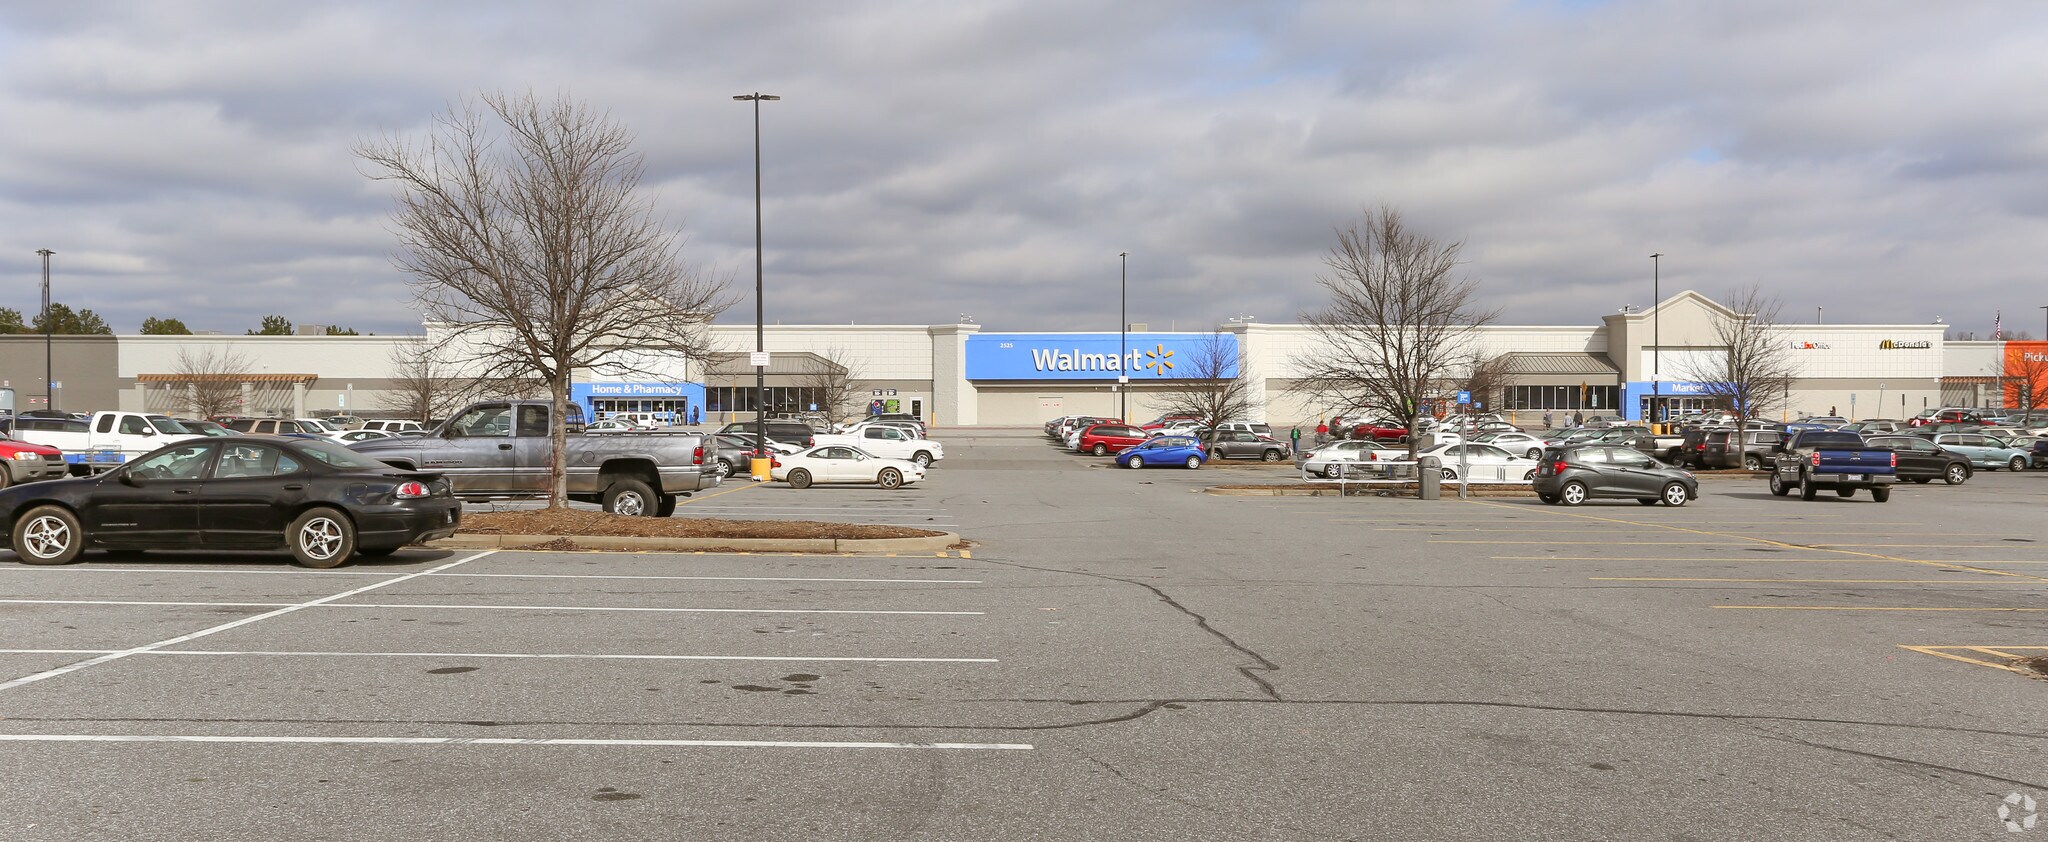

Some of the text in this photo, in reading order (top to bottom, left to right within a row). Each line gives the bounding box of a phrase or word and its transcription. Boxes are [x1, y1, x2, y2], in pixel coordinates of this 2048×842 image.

[1032, 348, 1141, 372] Walmart
[592, 384, 682, 396] Home & Pharmacy
[1672, 383, 1704, 392] Market
